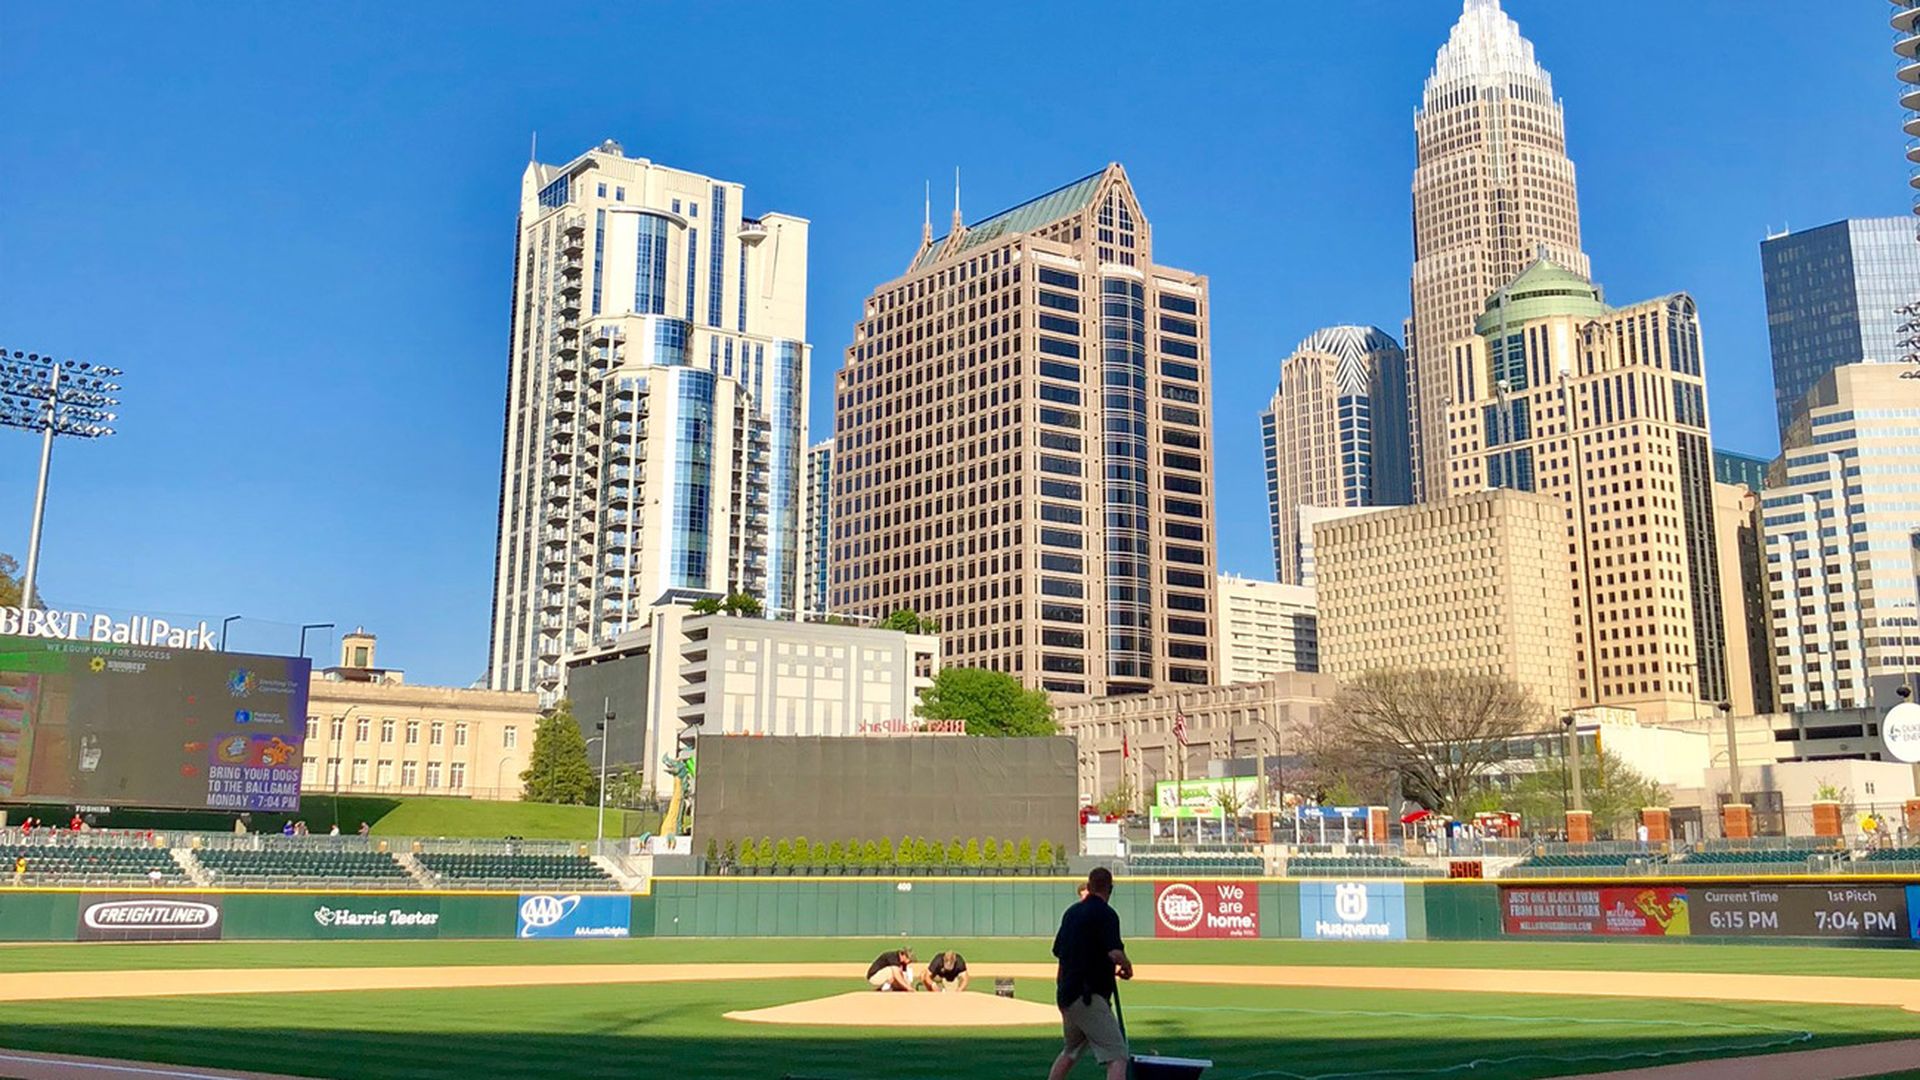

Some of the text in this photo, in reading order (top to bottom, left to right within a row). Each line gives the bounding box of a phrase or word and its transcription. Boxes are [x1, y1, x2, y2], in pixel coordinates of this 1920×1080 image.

[0, 606, 217, 650] BB&T BallPark
[46, 643, 60, 652] WE
[93, 647, 111, 656] YOU
[112, 648, 132, 657] FOR
[133, 649, 172, 661] SUCCESS
[209, 765, 299, 782] BRING YOUR DOGS
[208, 779, 298, 796] TO THE BALLGAME
[206, 793, 297, 808] MONDAY 7:04 PM
[75, 805, 111, 813] TOSHIBA
[897, 882, 912, 891] 400
[1217, 885, 1245, 900] We
[1509, 891, 1529, 904] JUST
[1704, 890, 1779, 903] Current Time
[1827, 889, 1878, 902] 1st Pitch
[97, 906, 206, 923] FREIGHTLINER
[523, 897, 561, 925] AAA
[1218, 901, 1243, 913] are
[1510, 904, 1533, 917] FROM
[1557, 904, 1601, 917] BALLPARK
[334, 909, 439, 925] Harris Teeter
[1709, 910, 1779, 929] 6:15 PM
[1814, 911, 1897, 931] 7:04 PM
[1315, 919, 1390, 937] Husqvarna
